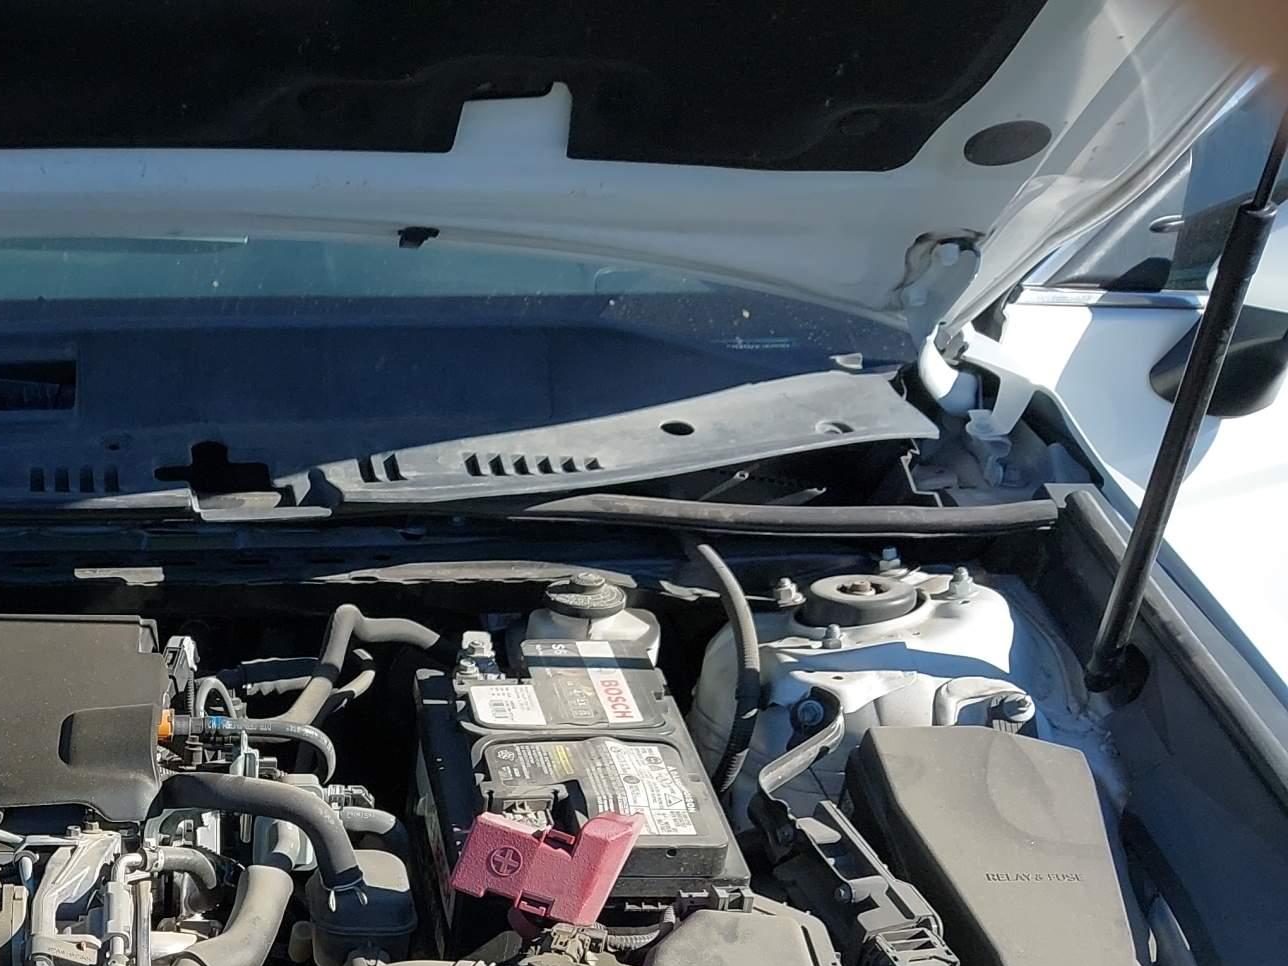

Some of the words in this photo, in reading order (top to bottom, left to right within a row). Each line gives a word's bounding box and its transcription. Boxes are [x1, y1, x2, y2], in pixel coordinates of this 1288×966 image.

[600, 679, 634, 720] BOSCH
[985, 872, 1032, 882] RELAY
[1046, 873, 1087, 882] FUSE
